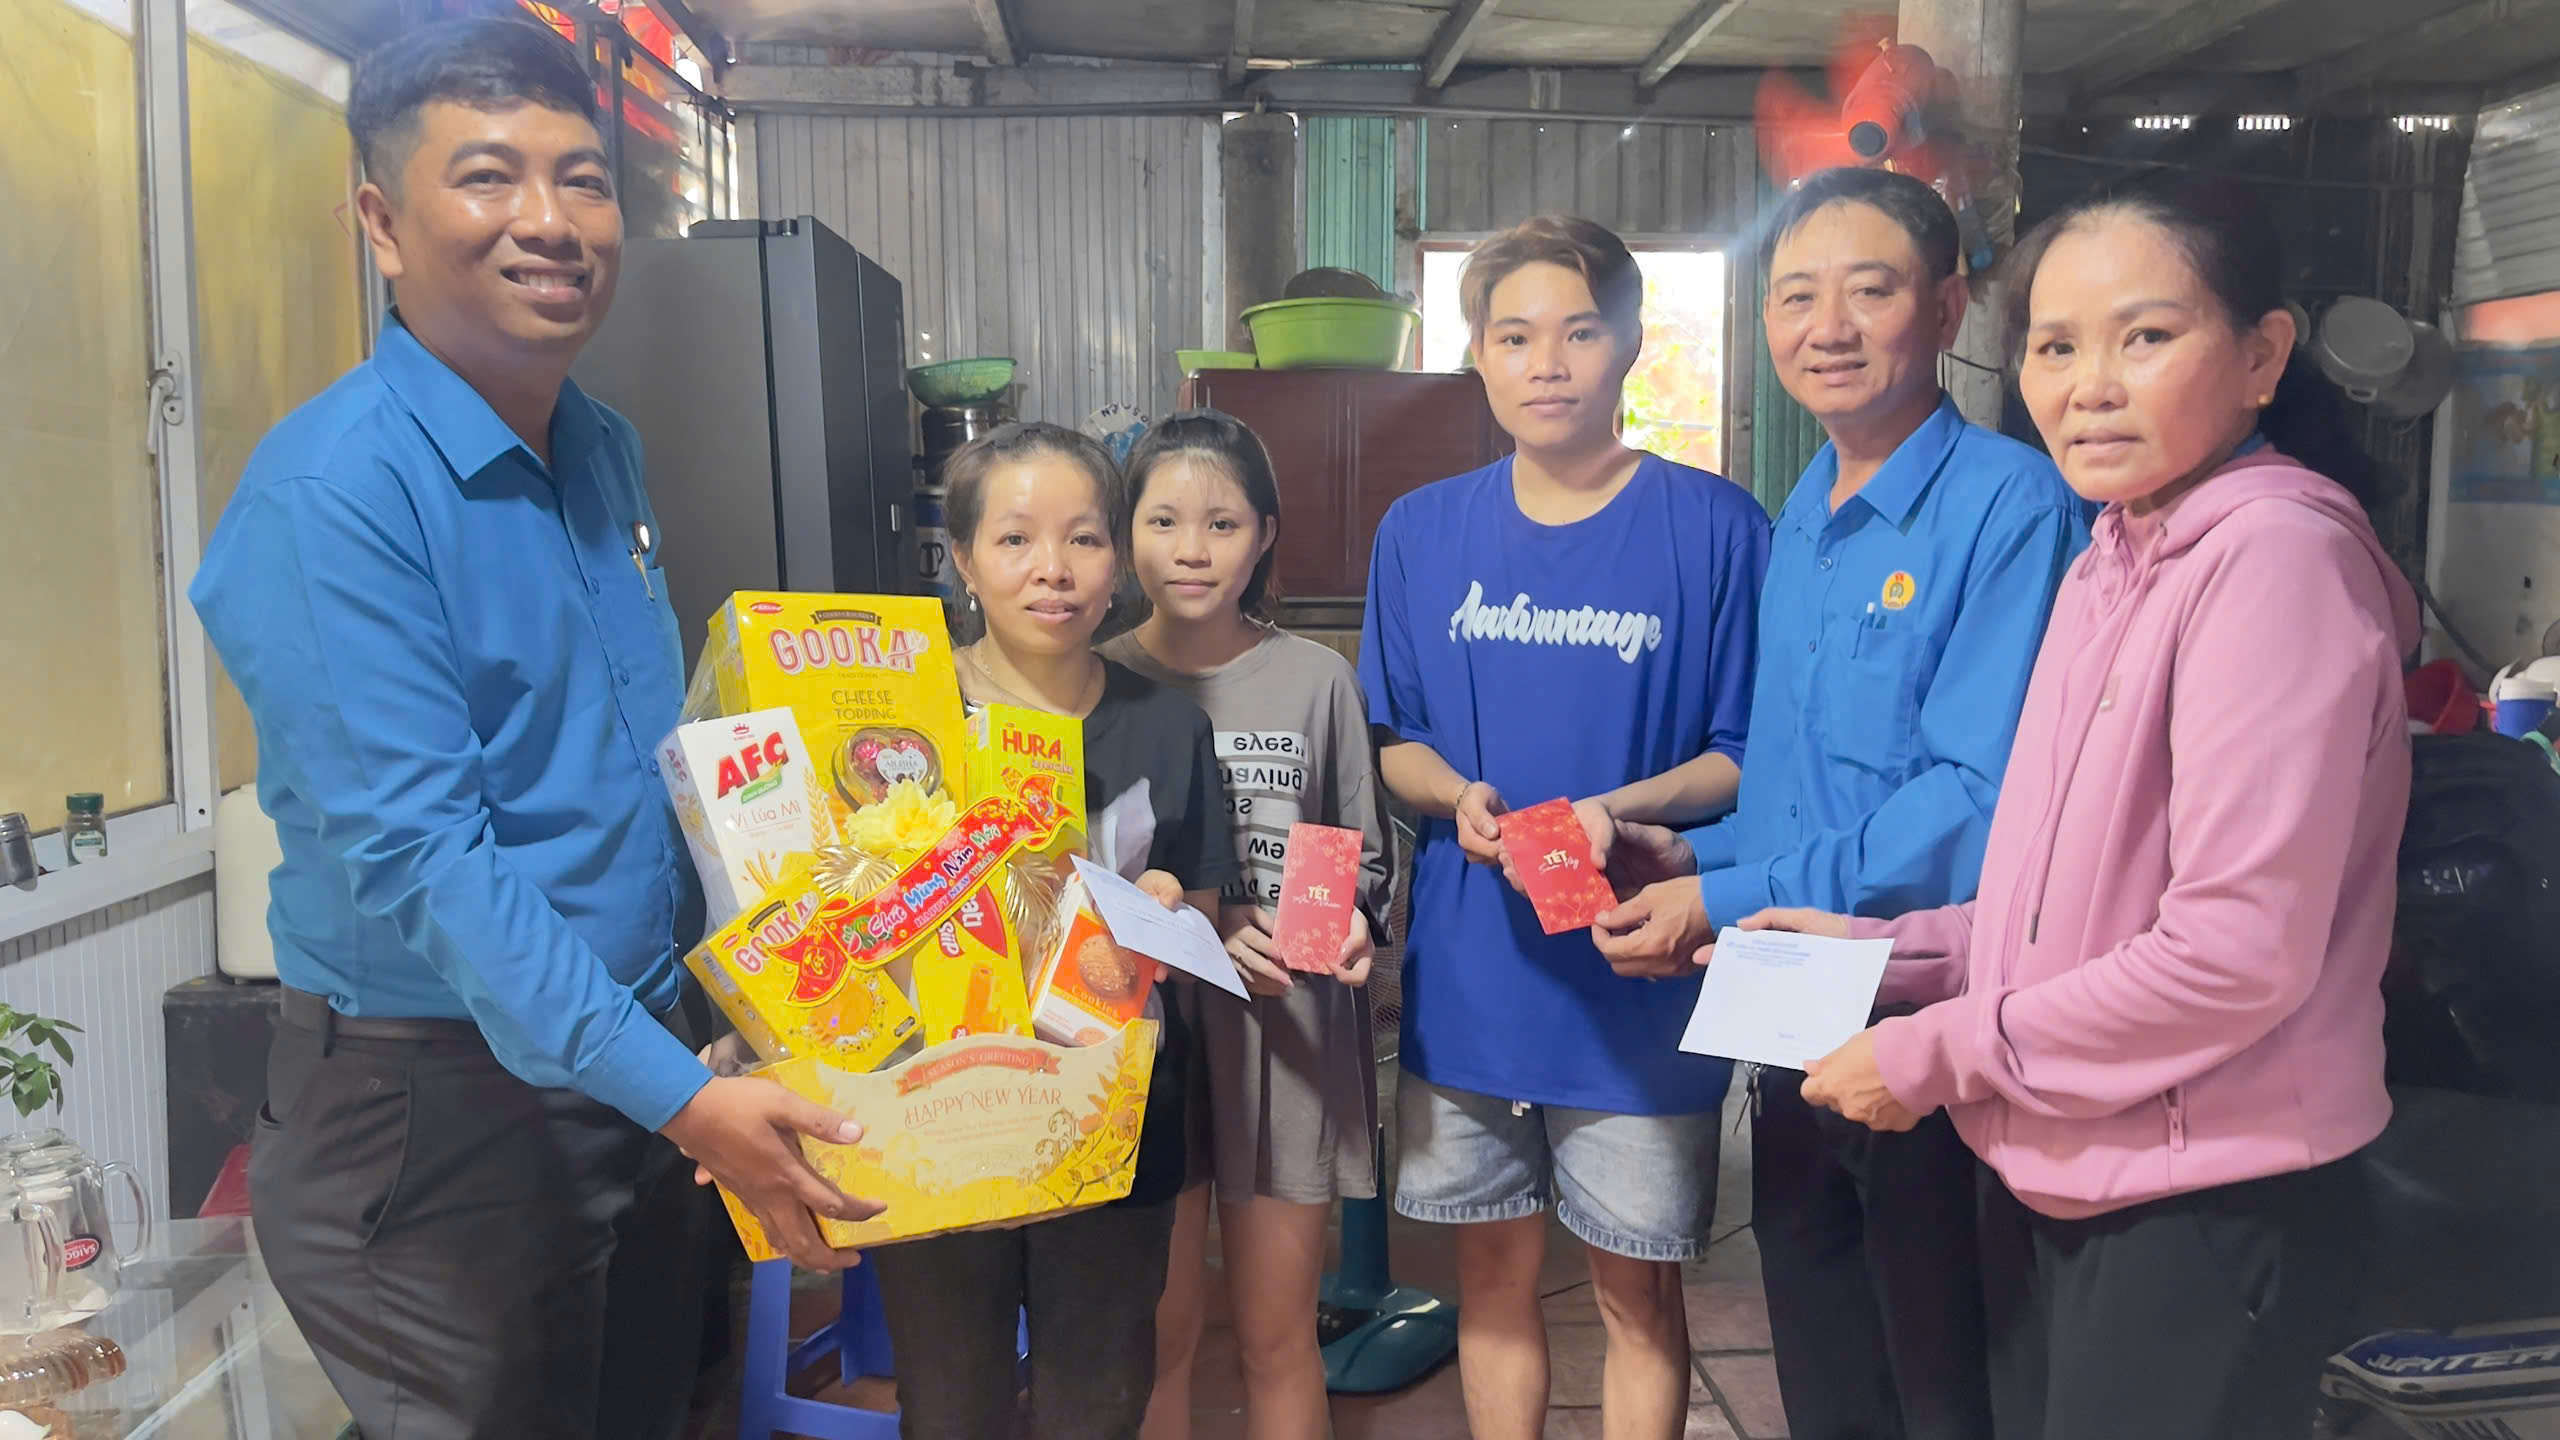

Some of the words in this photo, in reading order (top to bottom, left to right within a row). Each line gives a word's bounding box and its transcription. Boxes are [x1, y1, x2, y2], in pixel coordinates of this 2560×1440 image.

[768, 625, 916, 676] GOOKA
[831, 689, 895, 705] CHEESE
[833, 707, 897, 720] TOPPING
[1002, 728, 1061, 760] HURA
[717, 731, 790, 800] AFC
[905, 1094, 966, 1130] HAPPY
[968, 1088, 1011, 1113] NEW
[1017, 1084, 1062, 1105] YEAR
[2366, 1347, 2557, 1372] JUPITER
